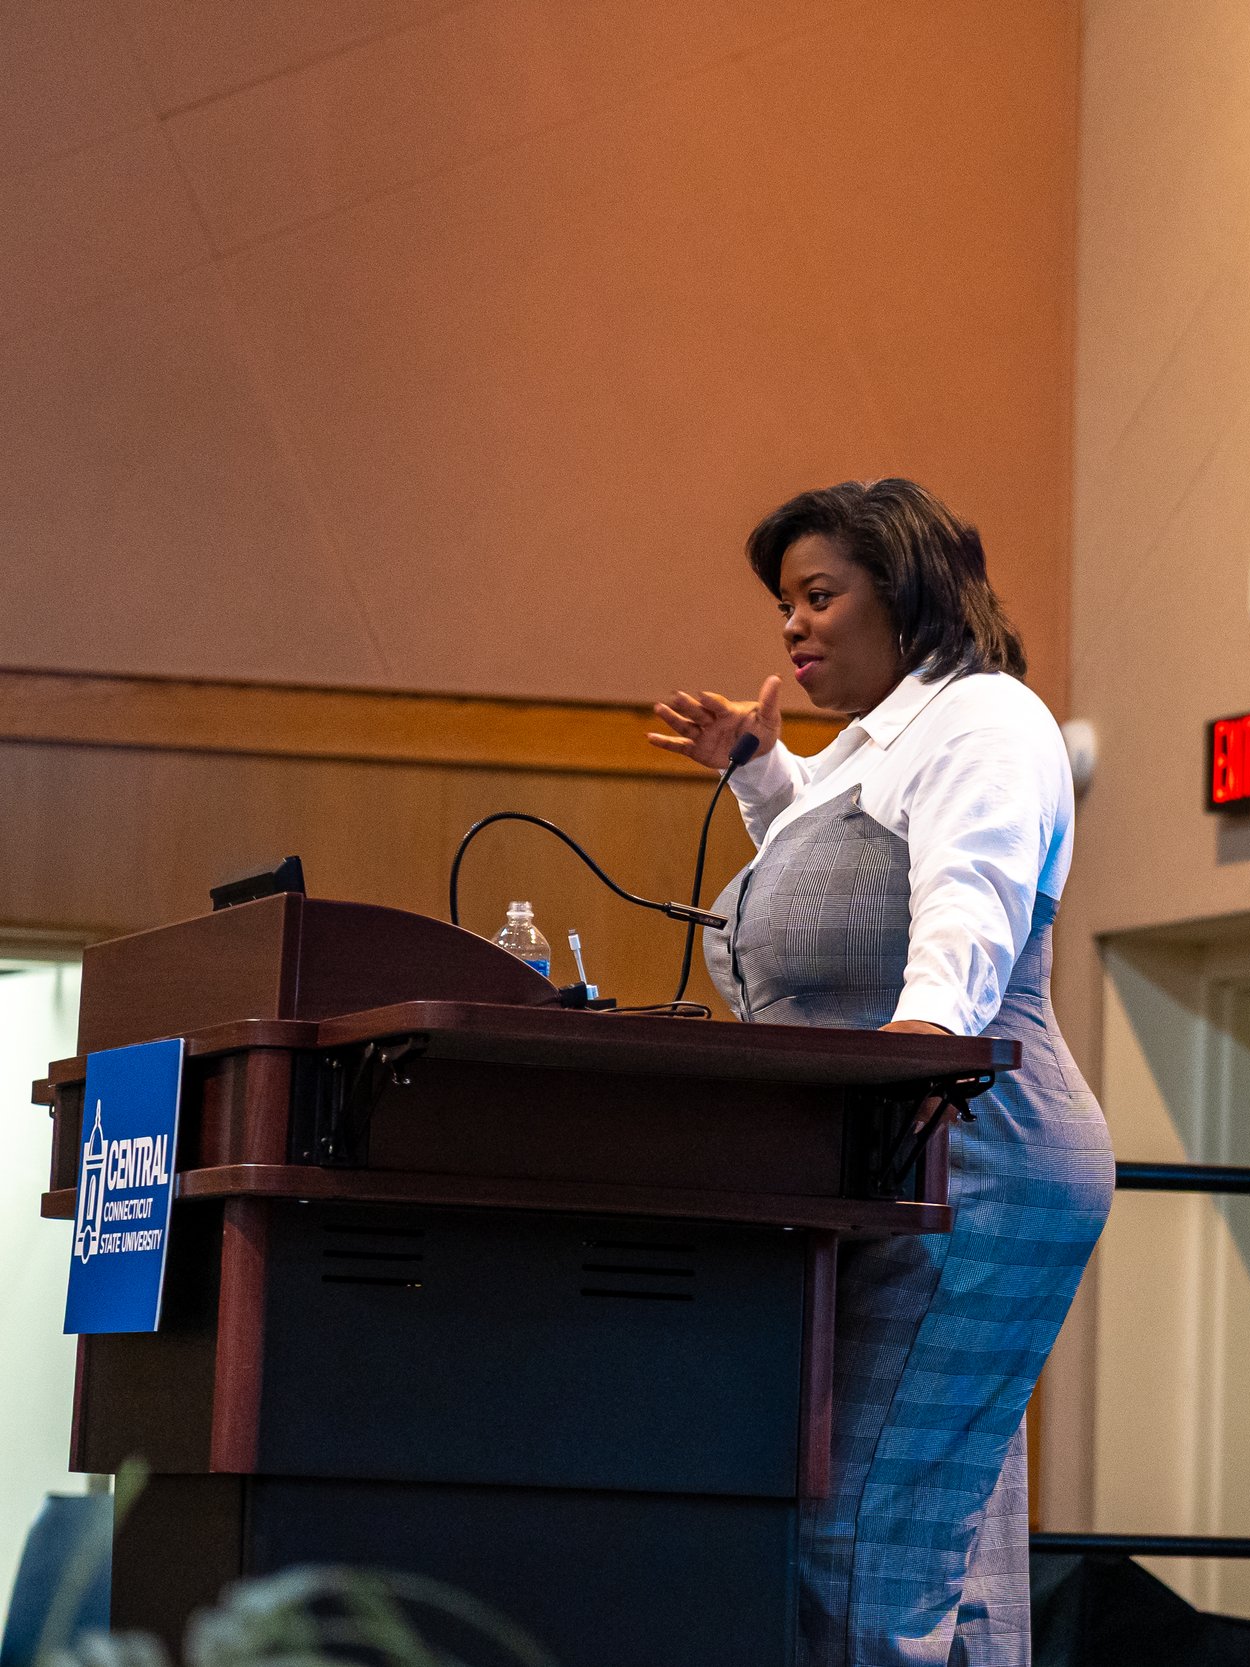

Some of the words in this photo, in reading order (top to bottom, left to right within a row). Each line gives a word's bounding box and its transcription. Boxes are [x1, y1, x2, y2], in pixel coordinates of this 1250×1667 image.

[107, 1134, 168, 1190] CENTRAL
[103, 1198, 154, 1222] CONNECTICUT
[100, 1233, 121, 1254] STATE
[121, 1229, 163, 1252] UNIVERSITY
